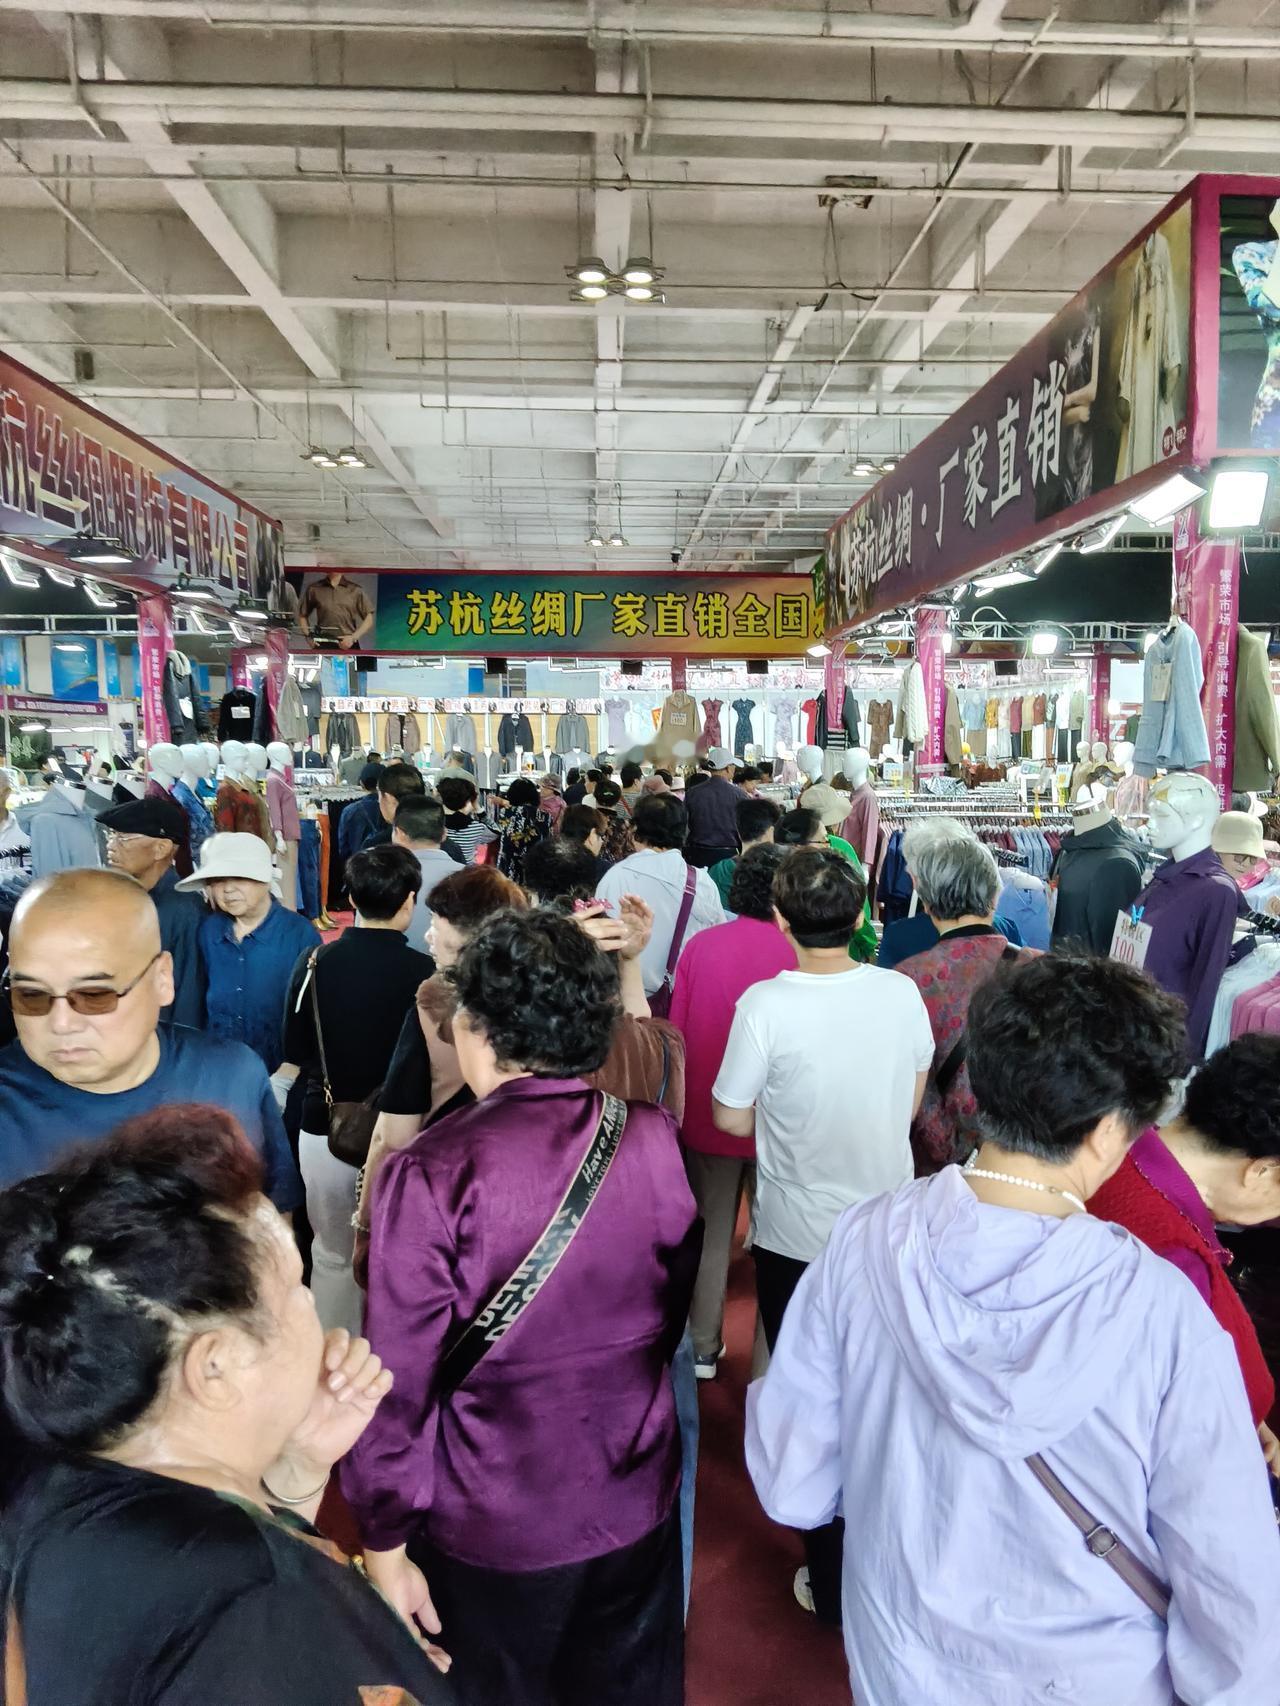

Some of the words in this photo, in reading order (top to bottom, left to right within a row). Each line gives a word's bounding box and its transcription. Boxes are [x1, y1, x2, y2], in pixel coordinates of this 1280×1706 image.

[407, 588, 824, 638] 苏杭丝绸厂家直销全国
[581, 1136, 608, 1184] Have
